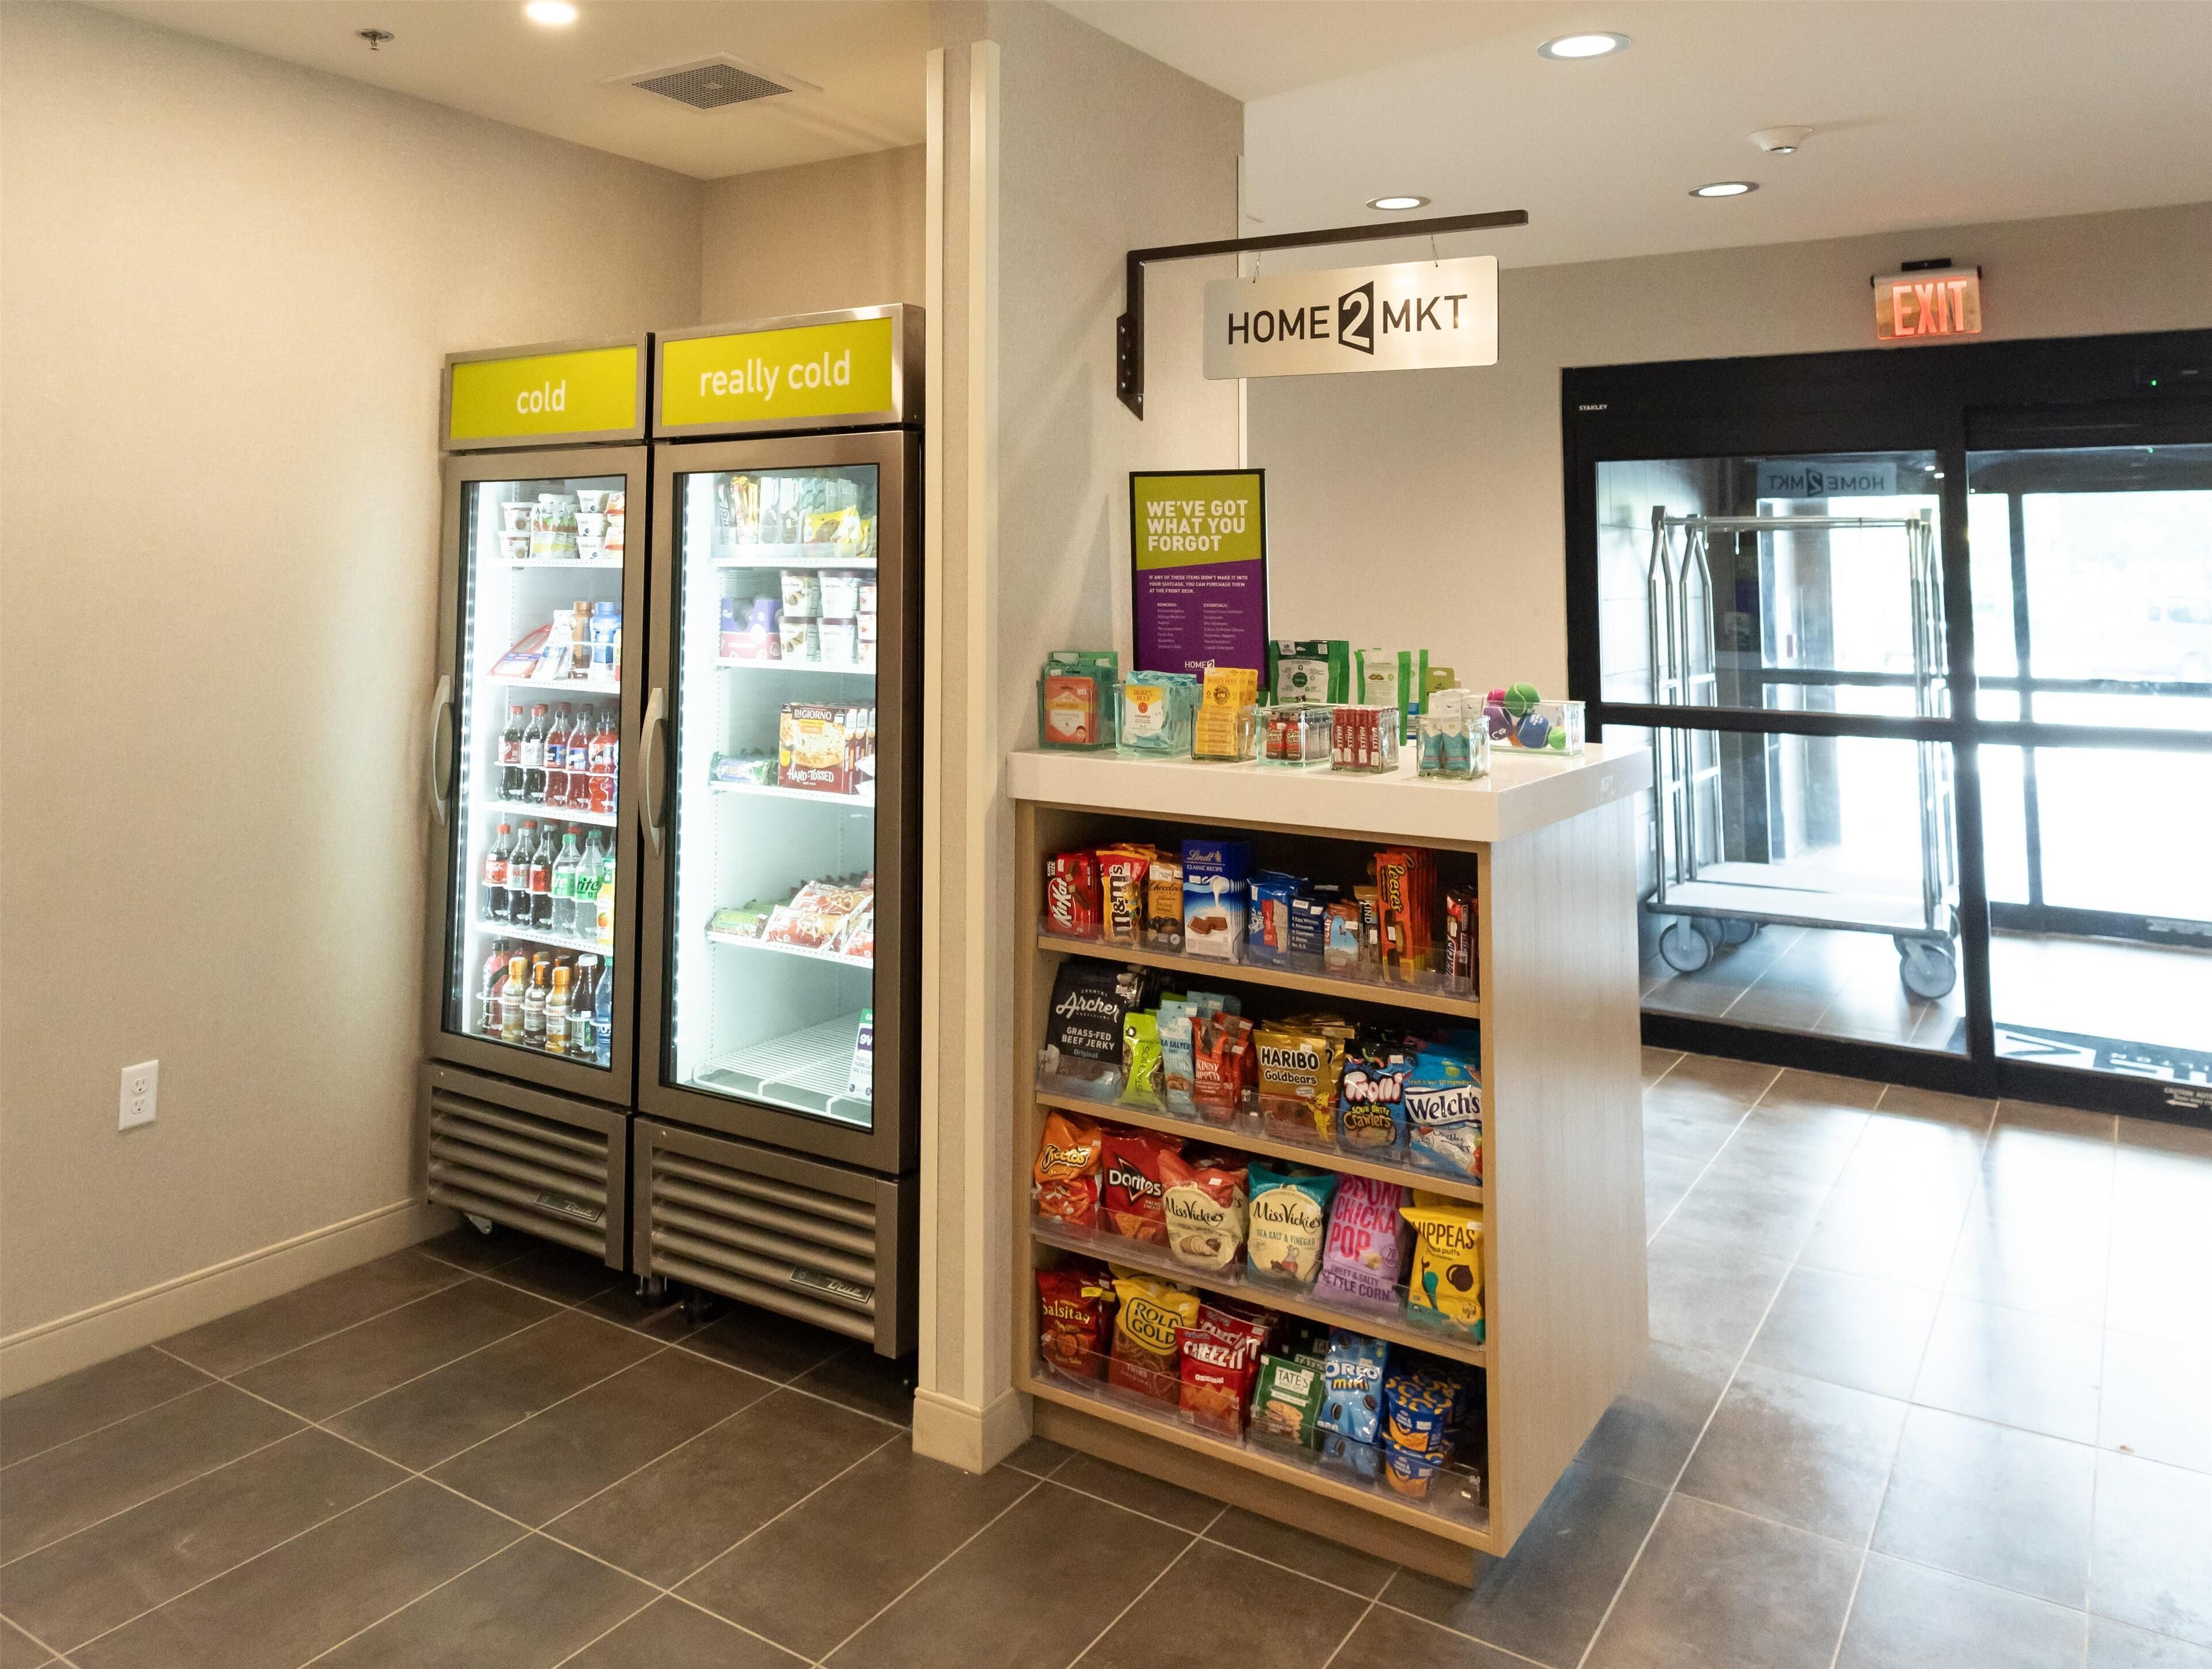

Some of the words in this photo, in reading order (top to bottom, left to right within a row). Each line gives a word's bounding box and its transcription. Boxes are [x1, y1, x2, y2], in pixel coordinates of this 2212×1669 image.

[1892, 281, 1968, 336] EXIT
[1228, 305, 1330, 345] HOME
[1382, 294, 1468, 334] MKT
[700, 358, 779, 401] really
[788, 349, 851, 389] cold
[516, 380, 567, 414] cold
[1146, 500, 1206, 517] WE'VE
[1210, 499, 1248, 517] GOT
[1146, 518, 1202, 534] WHAT
[1207, 517, 1245, 533] YOU
[1147, 535, 1222, 551] FORGOT
[1185, 661, 1207, 669] HOME
[577, 877, 599, 891] rite
[1149, 881, 1183, 891] Chocolov
[1364, 900, 1372, 924] KIND
[1081, 989, 1108, 997] COUNTRY
[1056, 991, 1120, 1023] Archer
[1062, 1034, 1084, 1046] BEEF
[1085, 1039, 1115, 1051] JERKY
[1067, 1027, 1111, 1041] GRASS-FED
[1074, 1049, 1099, 1059] Original
[1260, 1046, 1320, 1070] HARIBO
[854, 1061, 872, 1069] PARMESA
[1134, 1046, 1150, 1091] STACHIOS
[1264, 1070, 1318, 1085] Goldbears
[1344, 1071, 1403, 1102] Trolli
[1351, 1106, 1370, 1114] SOUR
[1407, 1092, 1480, 1121] Welch's
[1343, 1112, 1392, 1130] Crawlers
[1109, 1169, 1161, 1196] Doritos
[1165, 1196, 1188, 1217] Miss
[1185, 1200, 1225, 1227] Vickie's
[1253, 1201, 1284, 1223] Miss
[1281, 1203, 1321, 1234] Vickie's
[1335, 1196, 1395, 1236] CHICKA
[1256, 1228, 1267, 1238] SEA
[1268, 1231, 1282, 1240] SALT
[1283, 1234, 1288, 1243] &
[1290, 1235, 1316, 1246] VINEGAR
[1328, 1222, 1371, 1262] POP
[1388, 1247, 1396, 1259] 70
[1442, 1248, 1461, 1257] puffs
[1330, 1263, 1352, 1278] SWEET
[1358, 1271, 1379, 1286] SALTY
[1358, 1284, 1391, 1301] CORN
[1183, 1341, 1246, 1369] CHEEZ-IT
[1278, 1368, 1309, 1388] TATE'S
[1325, 1361, 1378, 1380] OREO
